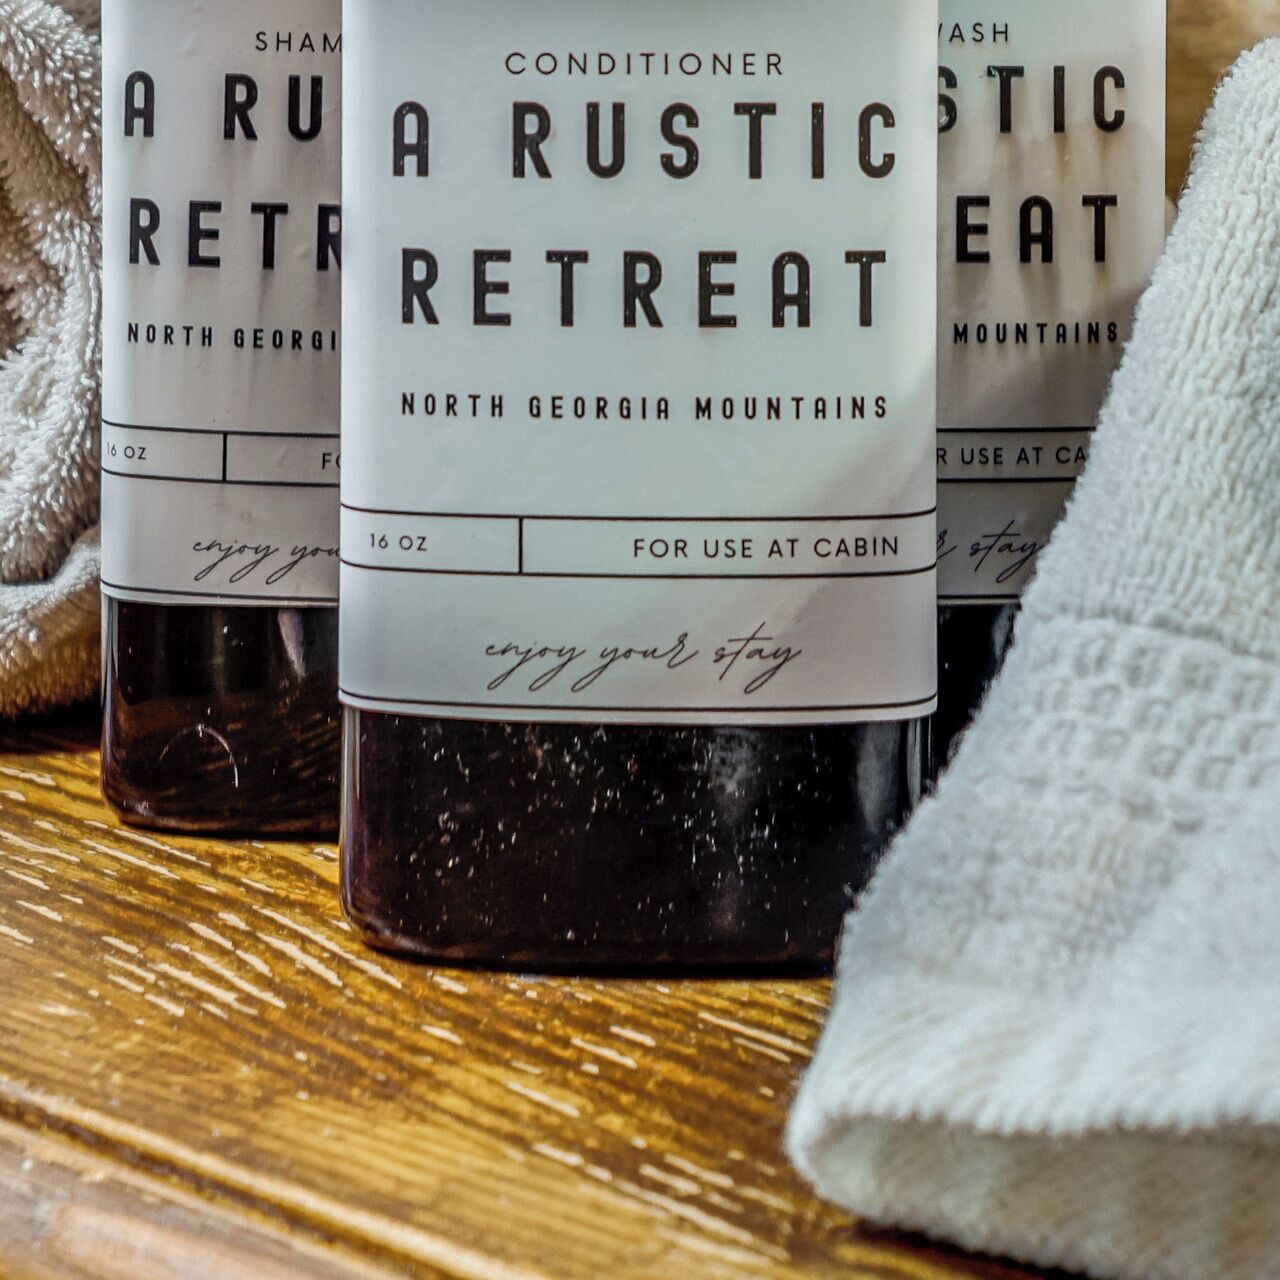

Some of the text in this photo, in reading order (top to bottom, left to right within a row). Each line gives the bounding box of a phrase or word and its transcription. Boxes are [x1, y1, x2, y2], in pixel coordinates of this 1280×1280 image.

[256, 31, 341, 54] SHAM
[938, 22, 1009, 43] ASH
[505, 52, 783, 75] CONDITIONER
[124, 71, 324, 141] A RU
[392, 101, 896, 179] A RUSTIC
[129, 198, 341, 271] RETR
[955, 195, 1118, 263] EAT
[401, 248, 886, 328] RETREAT
[127, 322, 338, 351] NORTH GEORGI
[953, 321, 1118, 345] MOUNTAINS
[401, 391, 887, 420] NORTH GEORGIA MOUNTAINS
[106, 441, 147, 461] 16 OZ
[960, 447, 1004, 465] USE
[1016, 447, 1044, 465] AT
[1055, 445, 1086, 464] CA
[369, 533, 428, 552] 16 OZ
[633, 535, 899, 559] FOR USE AT CABIN
[969, 520, 1047, 583] stay
[193, 540, 280, 583] enjoy
[484, 622, 803, 694] enjoy your stay
